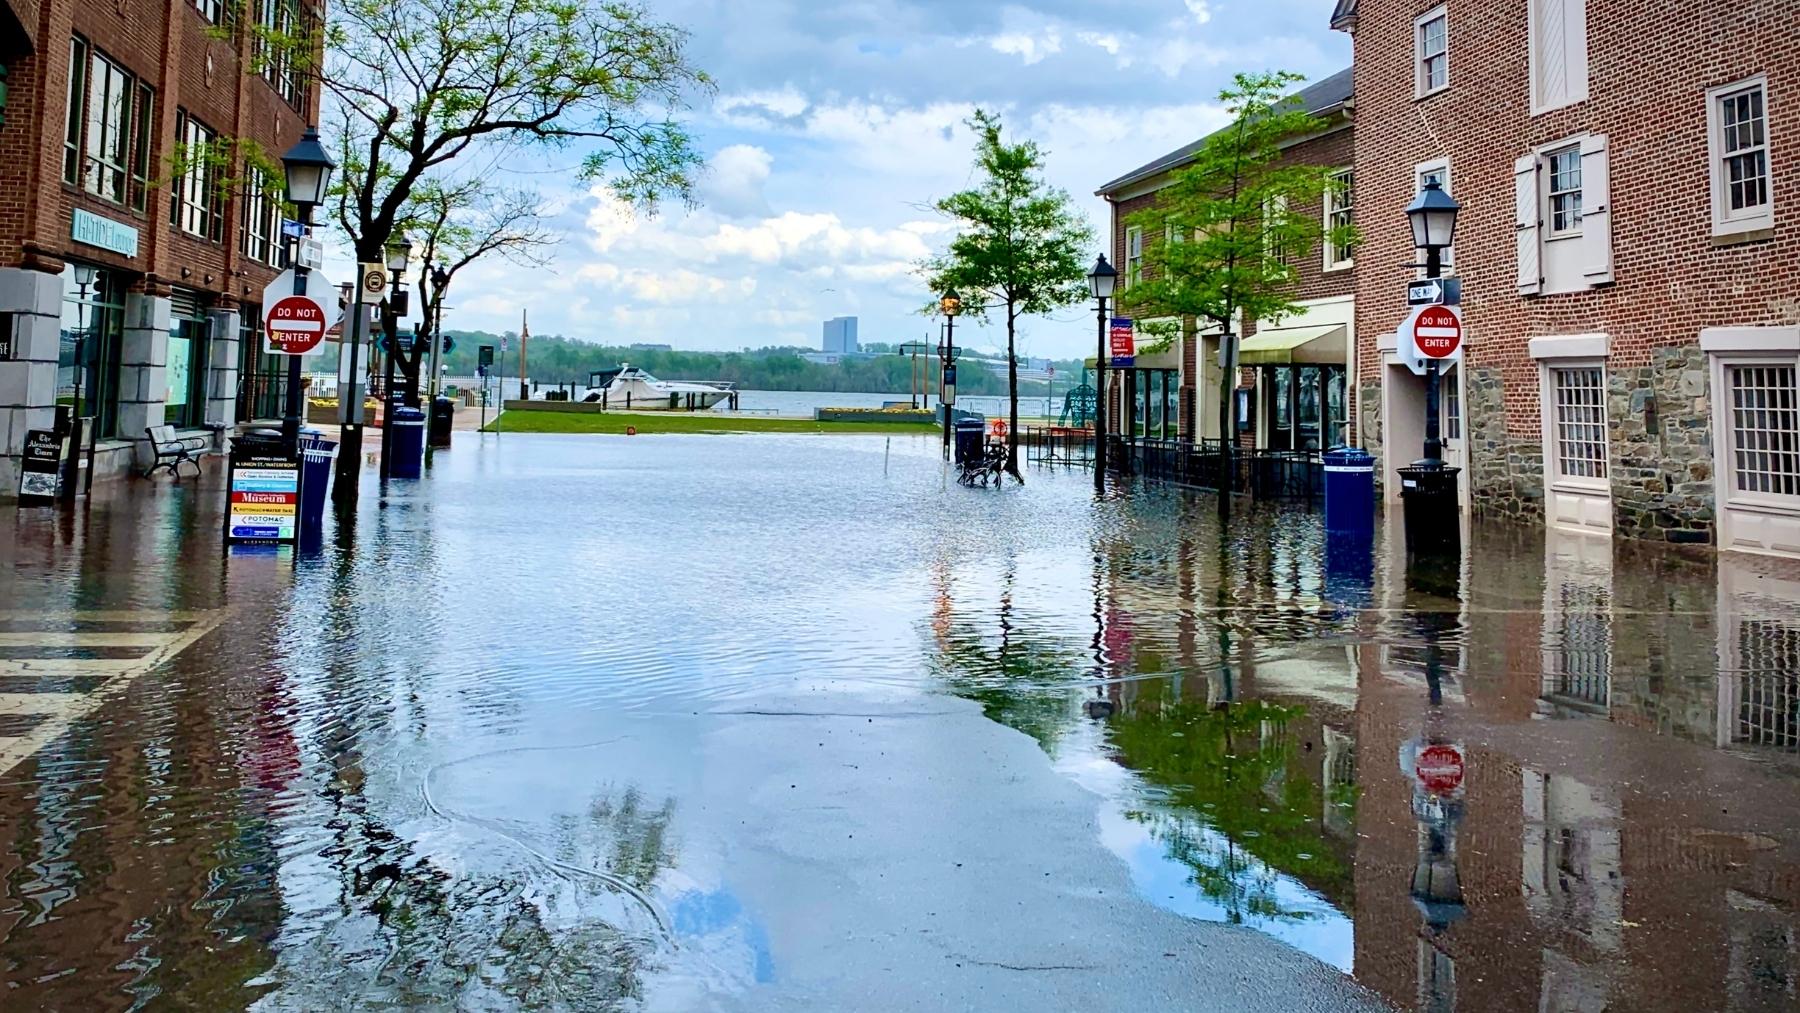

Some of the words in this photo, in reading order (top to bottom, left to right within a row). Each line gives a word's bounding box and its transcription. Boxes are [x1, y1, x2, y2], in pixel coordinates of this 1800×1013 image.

[1411, 288, 1421, 298] ONE
[1422, 286, 1433, 297] WAY
[277, 307, 292, 318] DO
[296, 308, 317, 318] NOT
[1421, 316, 1434, 326] DO
[1437, 317, 1453, 326] NOT
[279, 332, 311, 342] ENTER
[1425, 339, 1449, 347] ENTER
[39, 433, 51, 442] The
[35, 447, 53, 456] Times
[242, 492, 286, 503] Museum
